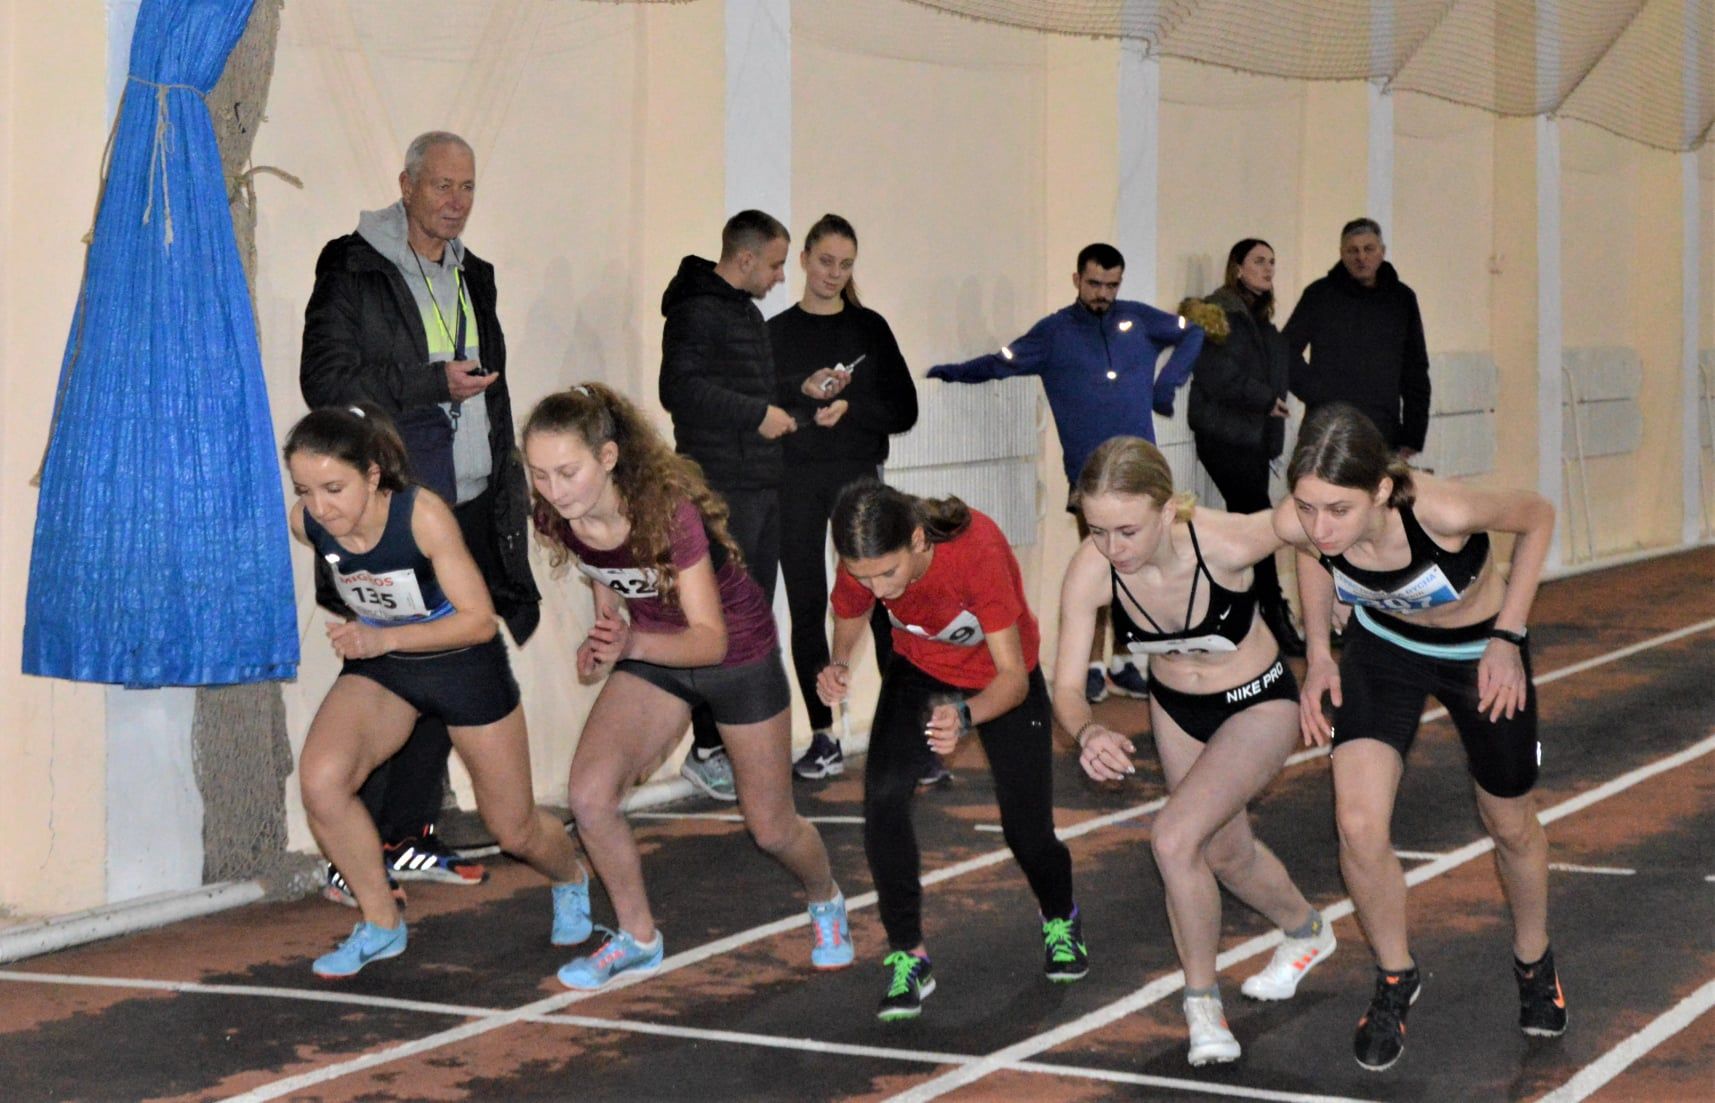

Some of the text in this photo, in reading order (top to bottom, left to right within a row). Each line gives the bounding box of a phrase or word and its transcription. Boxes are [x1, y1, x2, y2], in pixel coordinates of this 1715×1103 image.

[351, 586, 398, 610] 135
[1226, 661, 1284, 704] NIKE PRO
